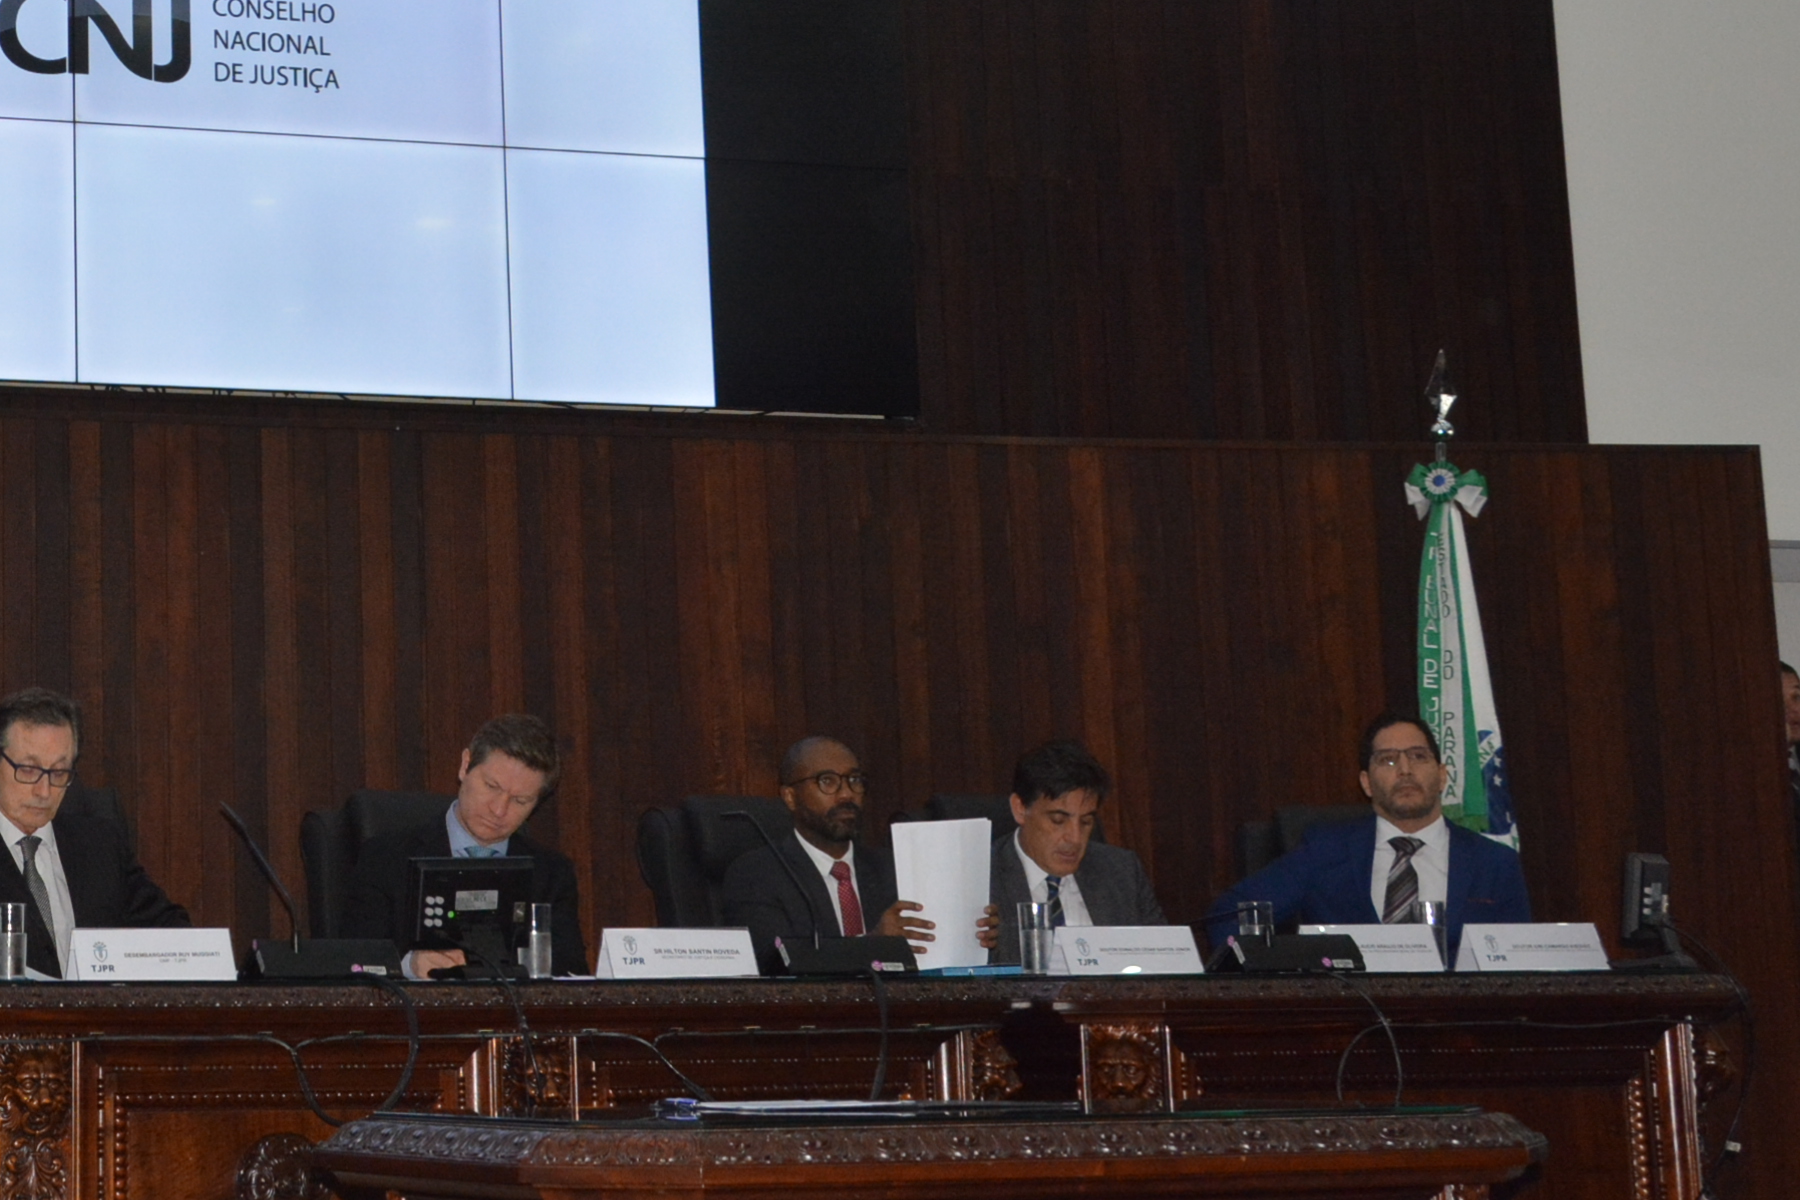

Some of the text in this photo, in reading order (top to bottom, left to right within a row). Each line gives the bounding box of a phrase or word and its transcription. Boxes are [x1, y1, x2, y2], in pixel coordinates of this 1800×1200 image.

[213, 28, 332, 57] NACIONAL
[214, 61, 340, 94] DE JUSTIÇA
[1443, 650, 1455, 681] DO
[622, 957, 646, 966] TJPR
[1077, 958, 1099, 967] TJPR
[1486, 954, 1508, 962] TJPR
[90, 964, 115, 973] TJPR
